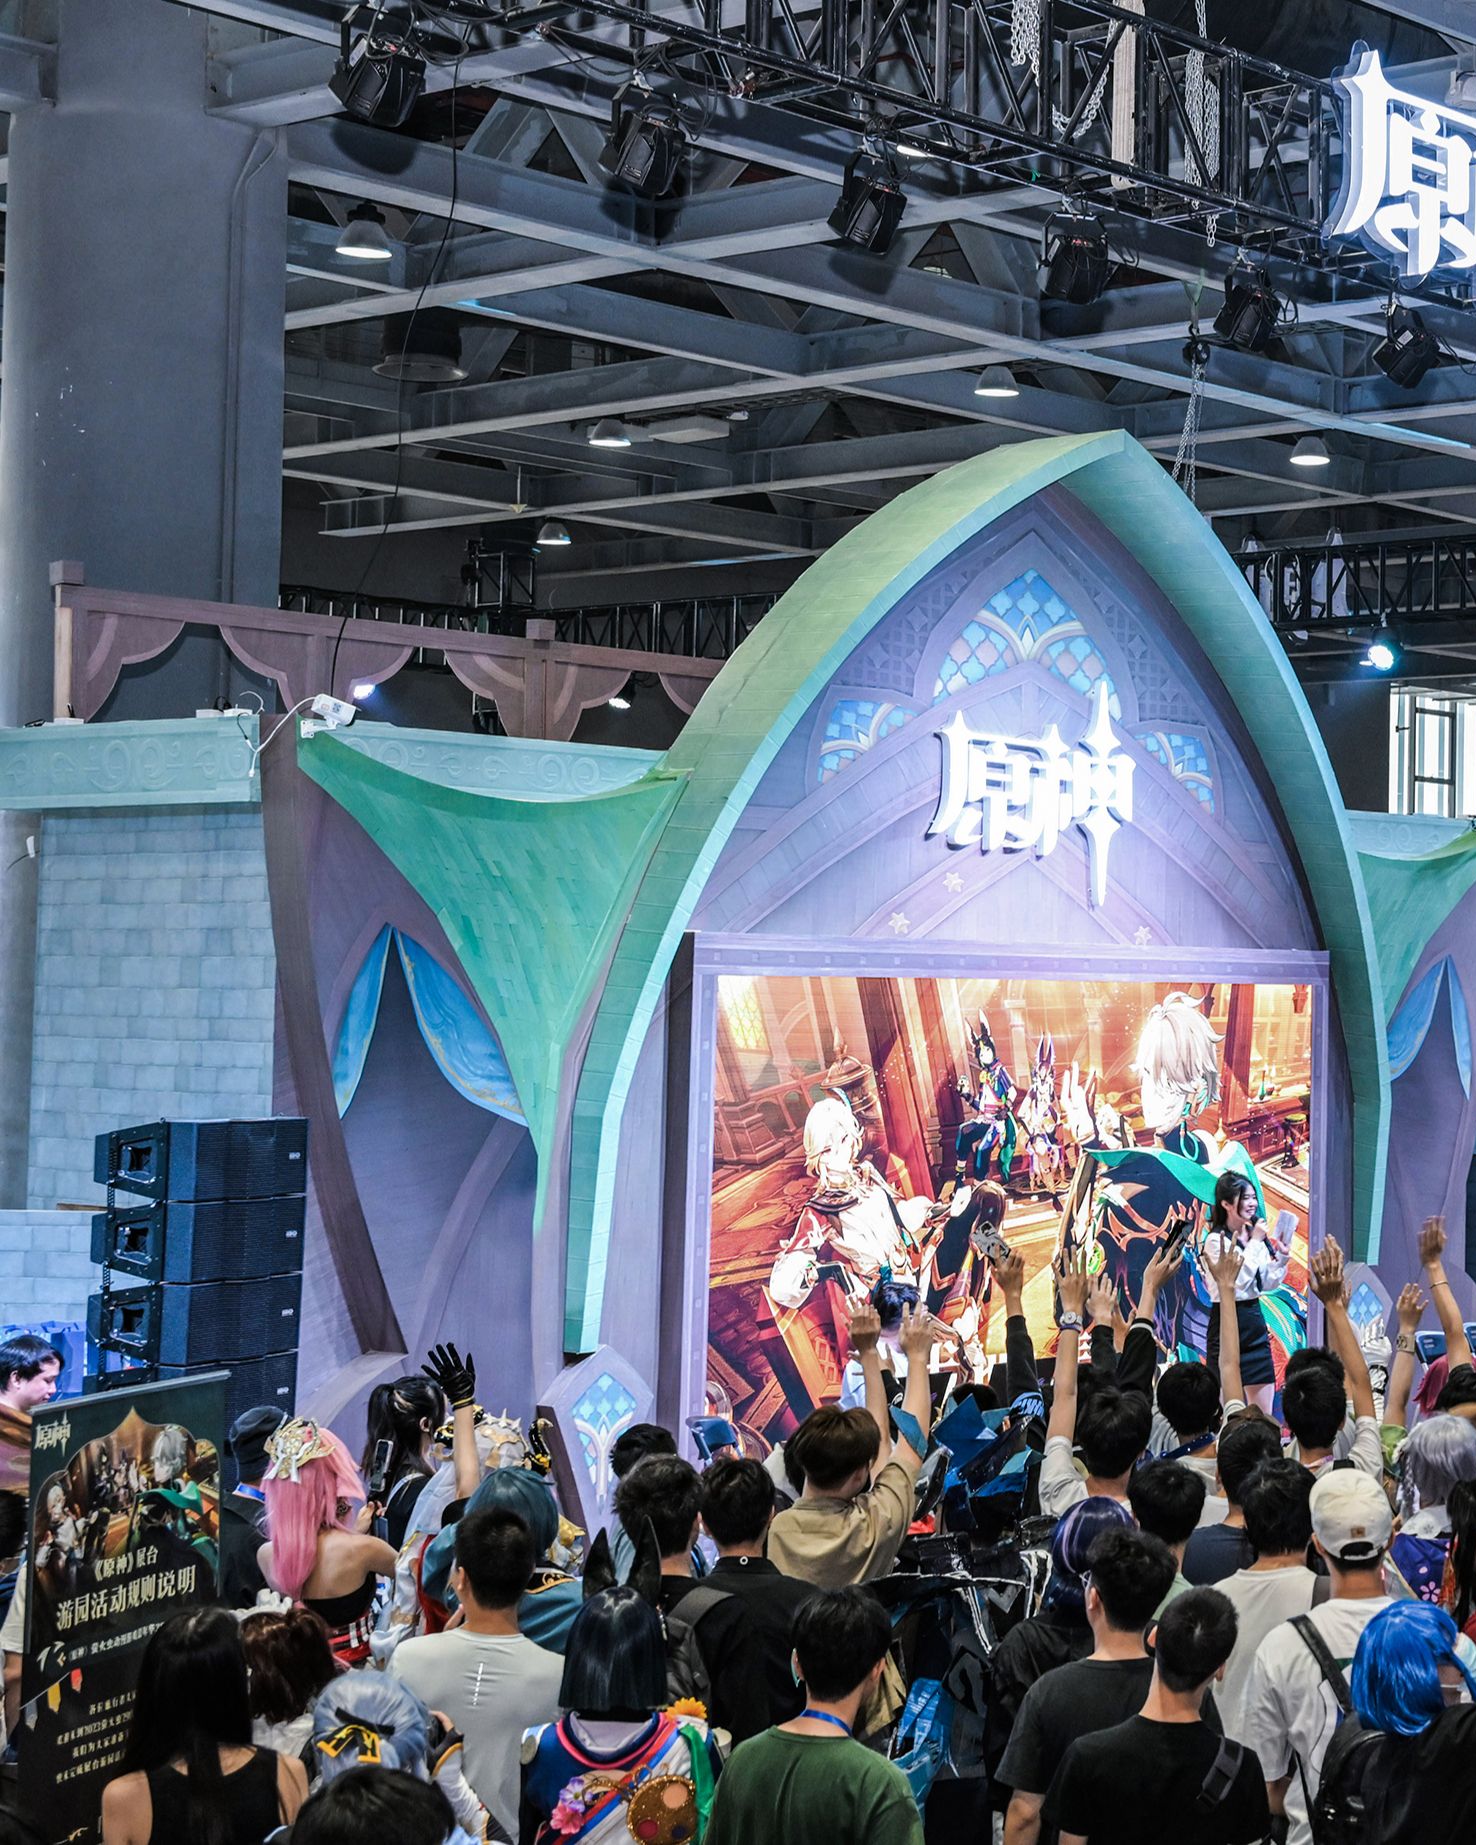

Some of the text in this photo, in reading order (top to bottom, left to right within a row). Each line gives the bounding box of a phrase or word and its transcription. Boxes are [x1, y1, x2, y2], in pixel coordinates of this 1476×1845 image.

[926, 680, 1136, 907] 原神
[34, 1410, 72, 1457] 原神
[56, 1565, 197, 1631] 游园活动规则说明
